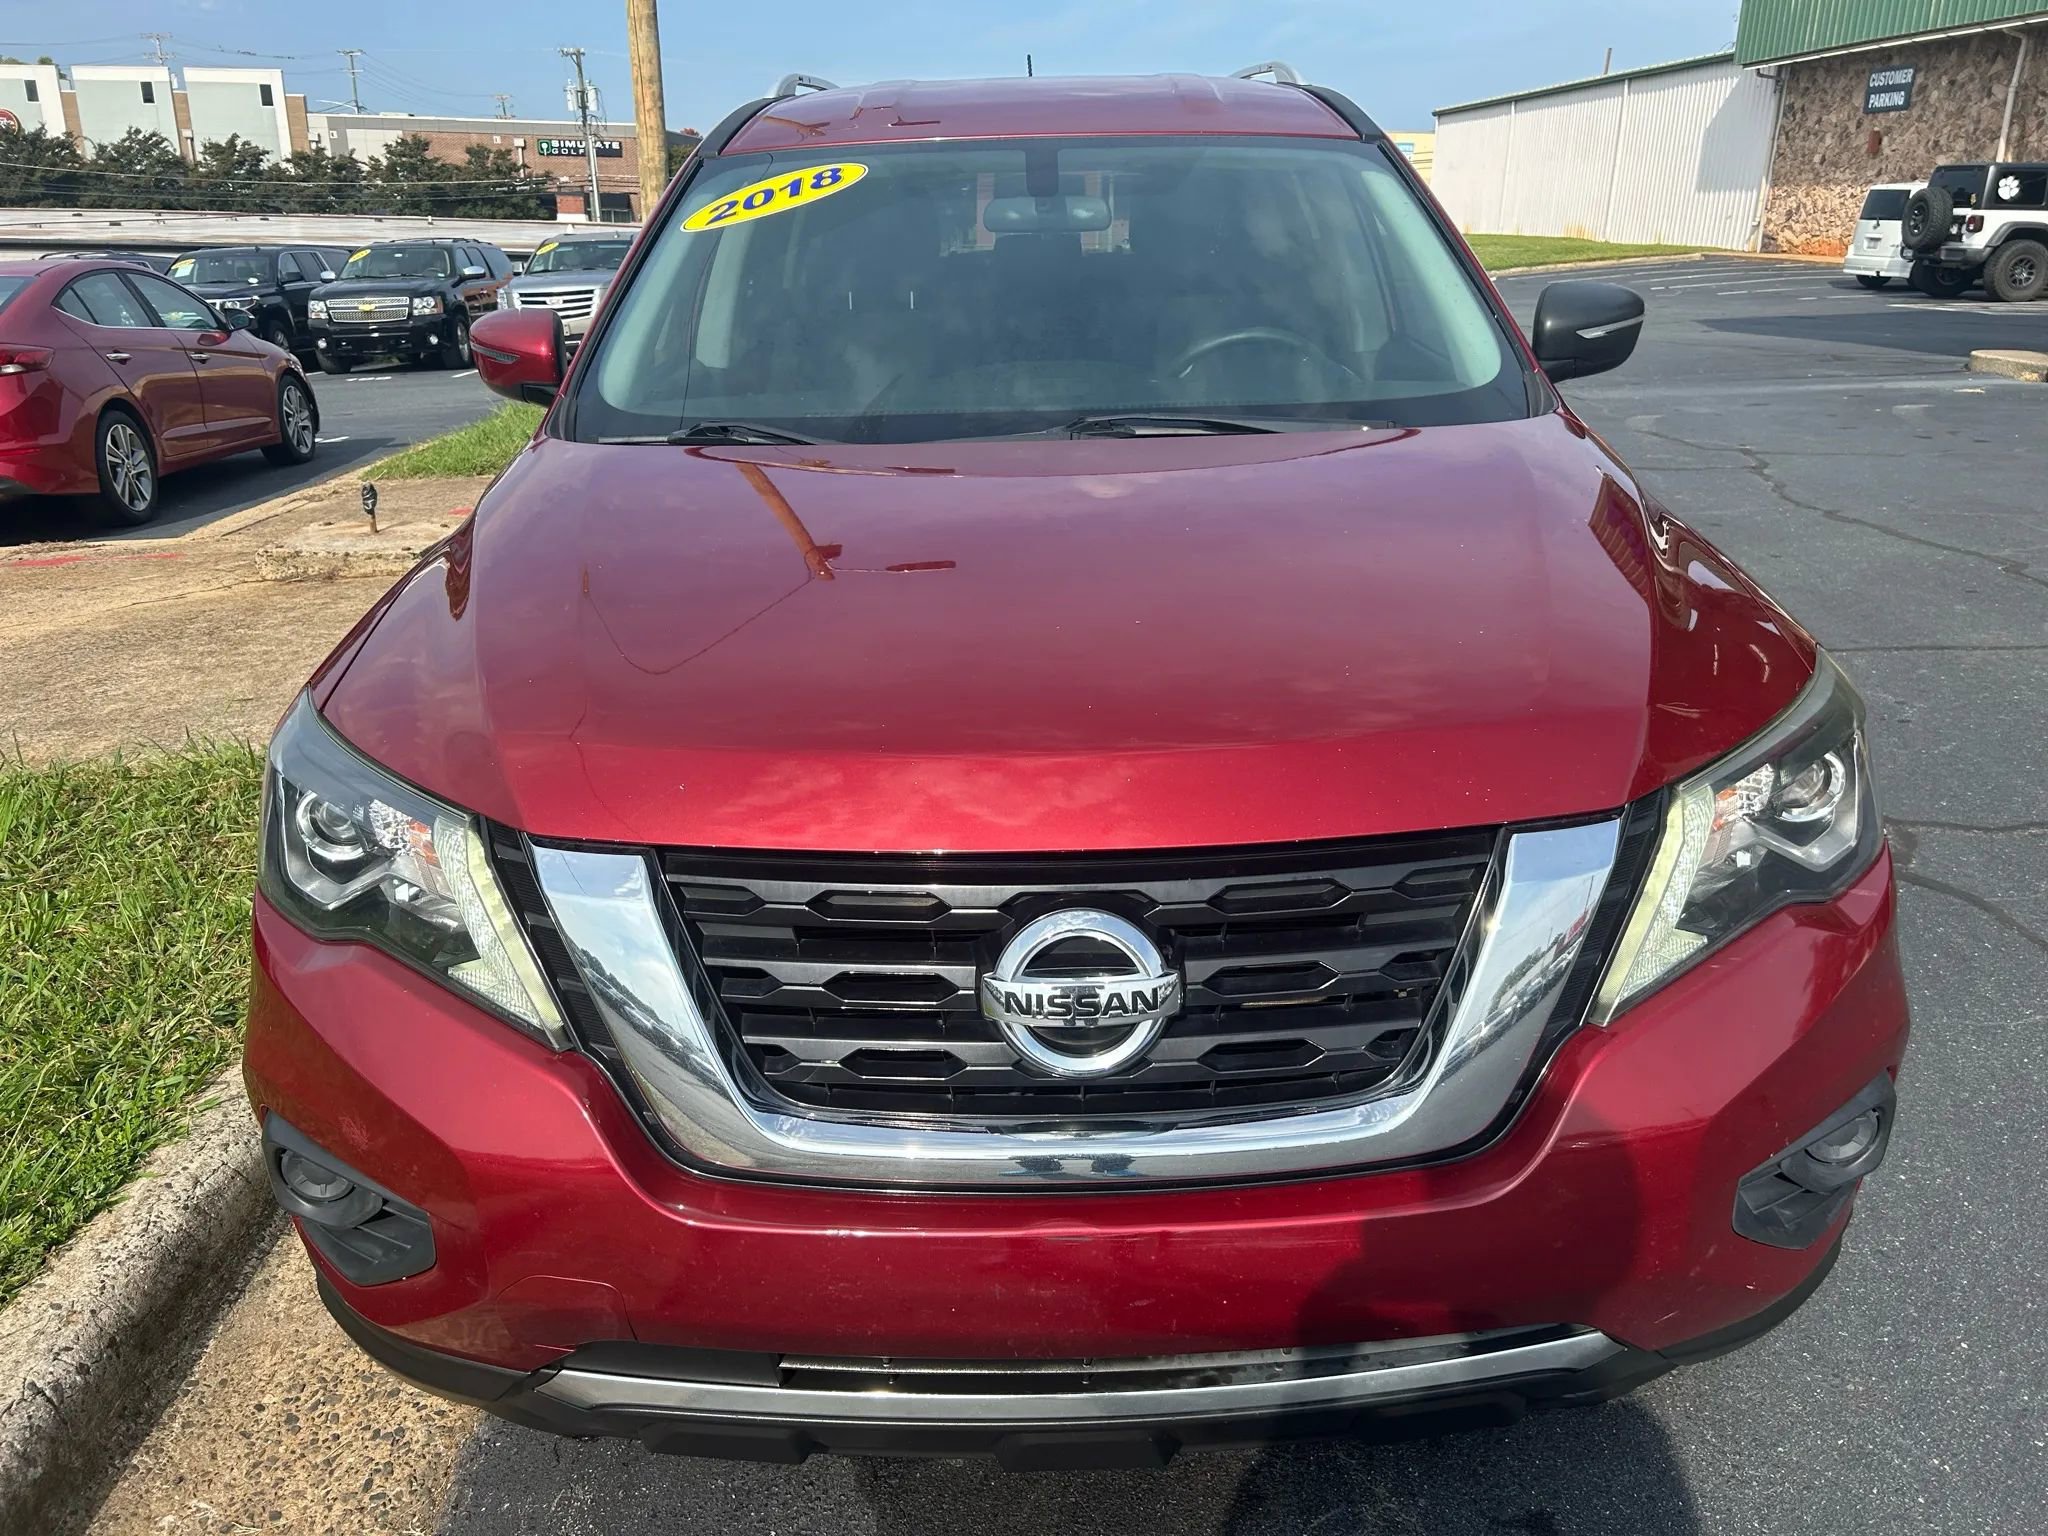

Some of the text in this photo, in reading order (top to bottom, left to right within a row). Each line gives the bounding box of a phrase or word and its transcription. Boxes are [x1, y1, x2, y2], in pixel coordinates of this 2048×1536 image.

[1869, 68, 1914, 87] CUSTOMER
[1868, 91, 1905, 109] PARKING
[551, 140, 620, 149] SIMUATE
[705, 167, 843, 226] 2018
[1004, 987, 1160, 1018] NISSAN
